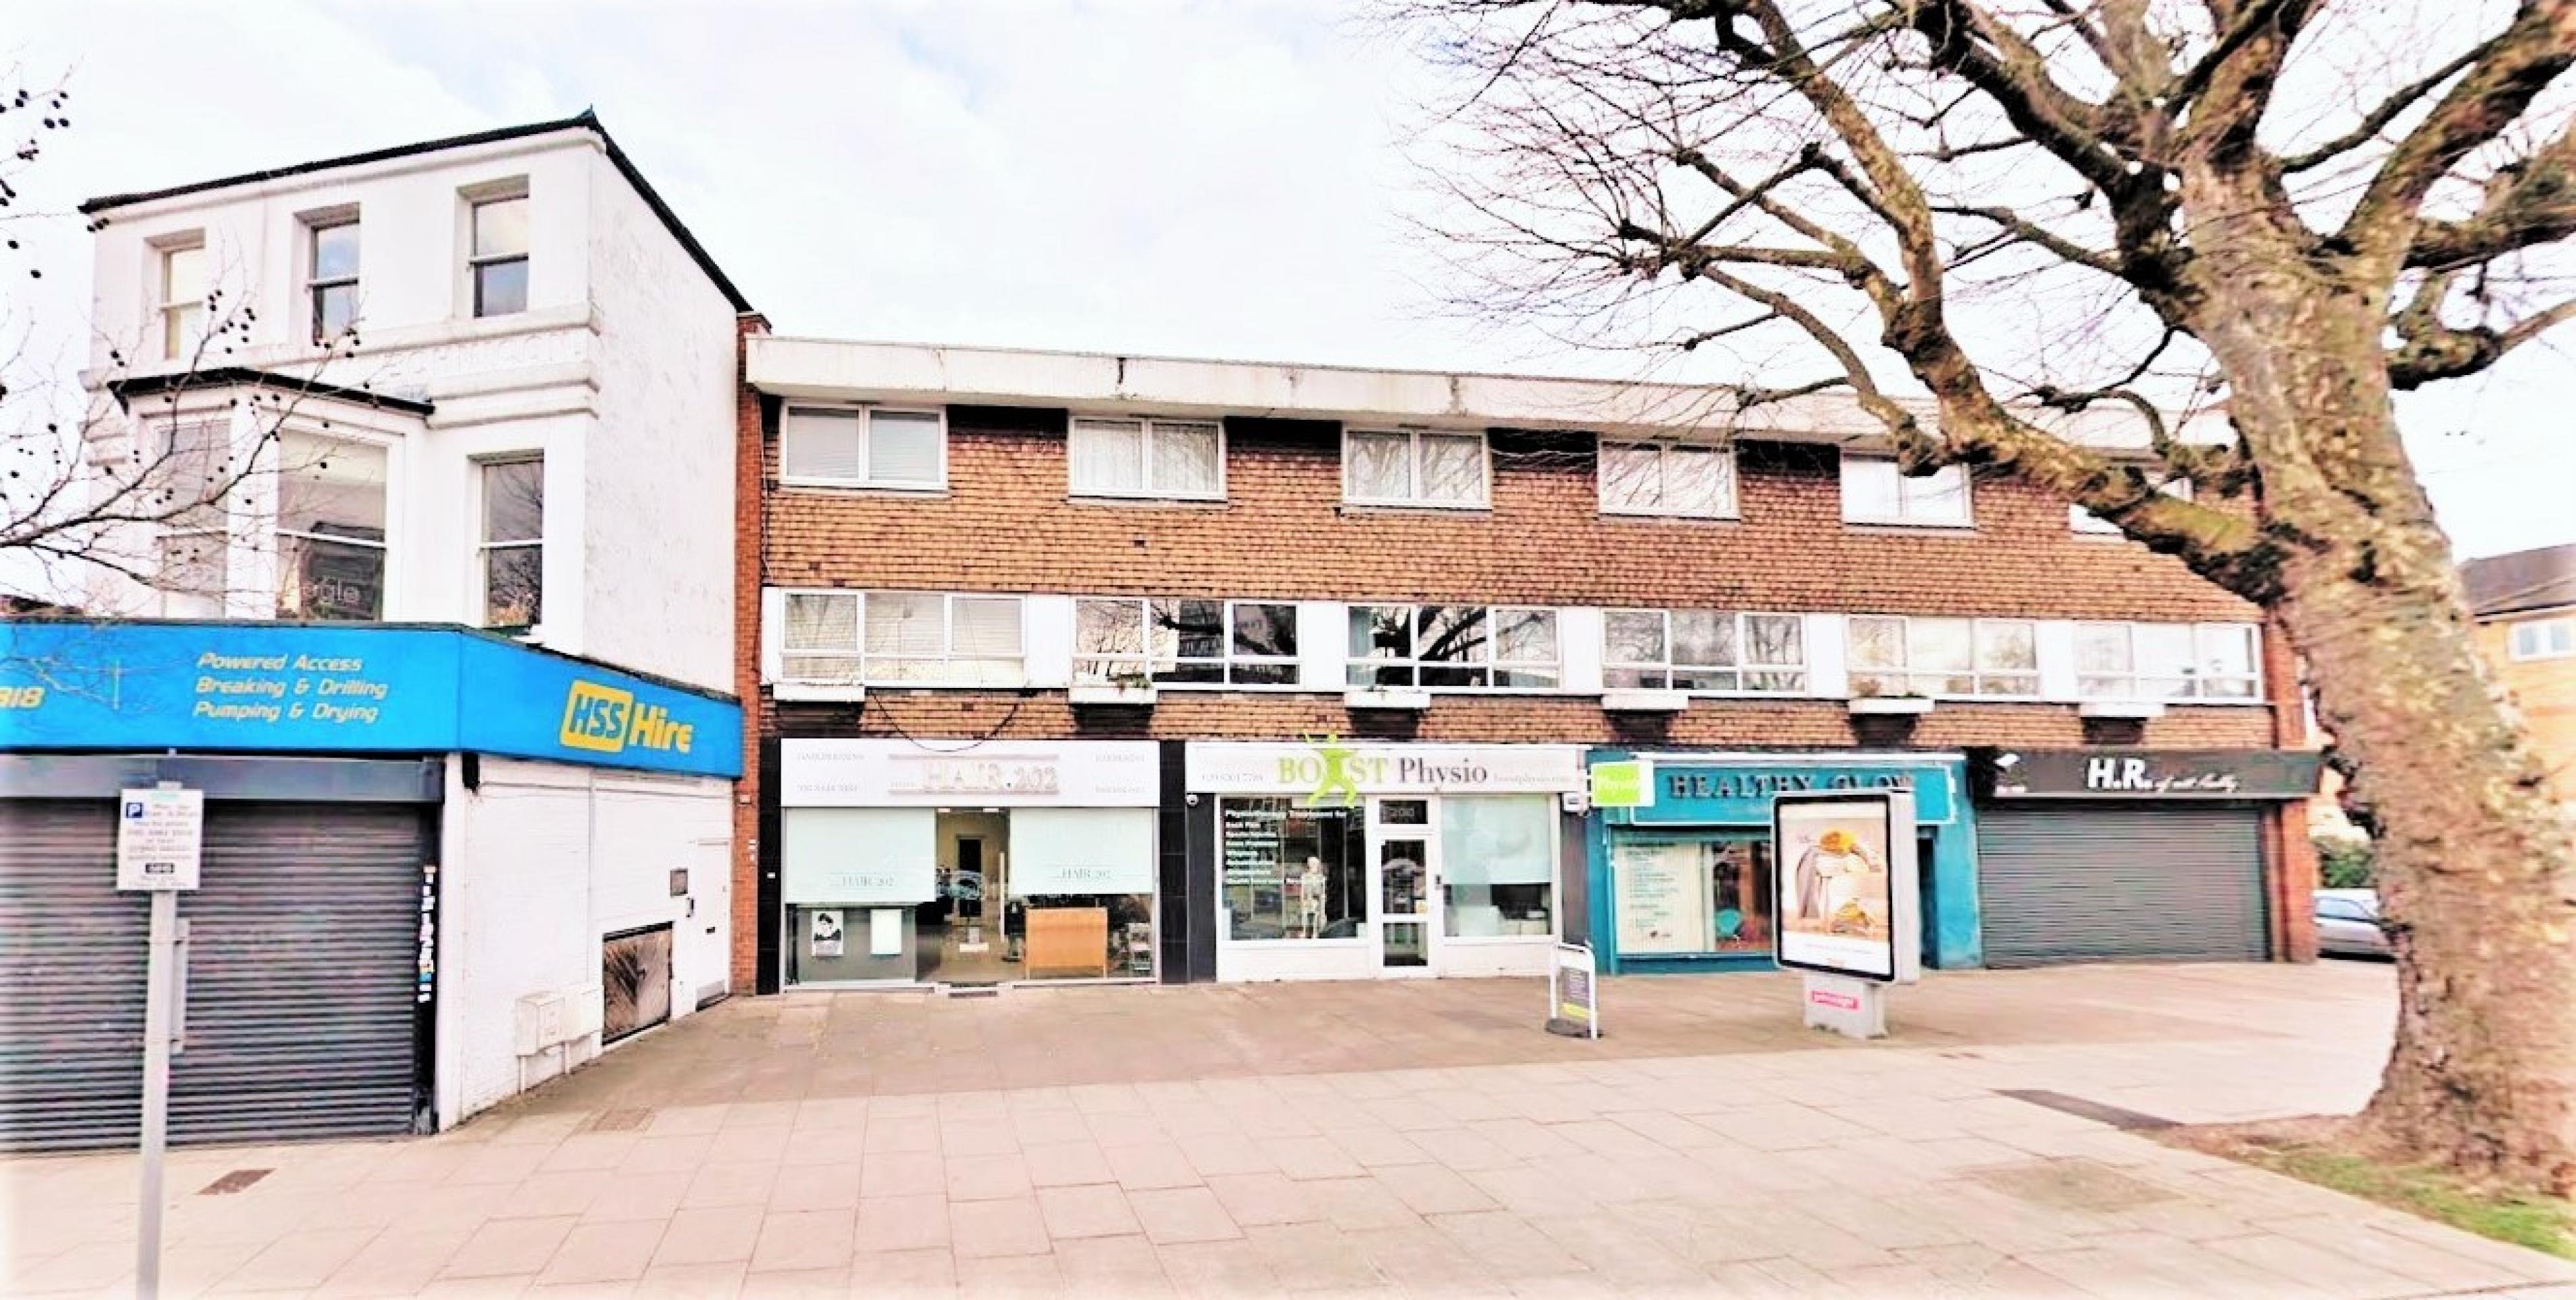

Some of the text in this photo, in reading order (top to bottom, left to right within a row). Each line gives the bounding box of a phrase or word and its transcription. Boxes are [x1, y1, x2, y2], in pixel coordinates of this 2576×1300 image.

[196, 653, 362, 671] Powered Access
[196, 676, 388, 699] Breaking & Drilling
[192, 701, 379, 722] Pumping & Drying
[569, 693, 694, 754] HSS Hire
[1277, 756, 1487, 785] BOST Physio
[2088, 757, 2153, 789] H.R.
[1669, 774, 1813, 798] HEALTHY
